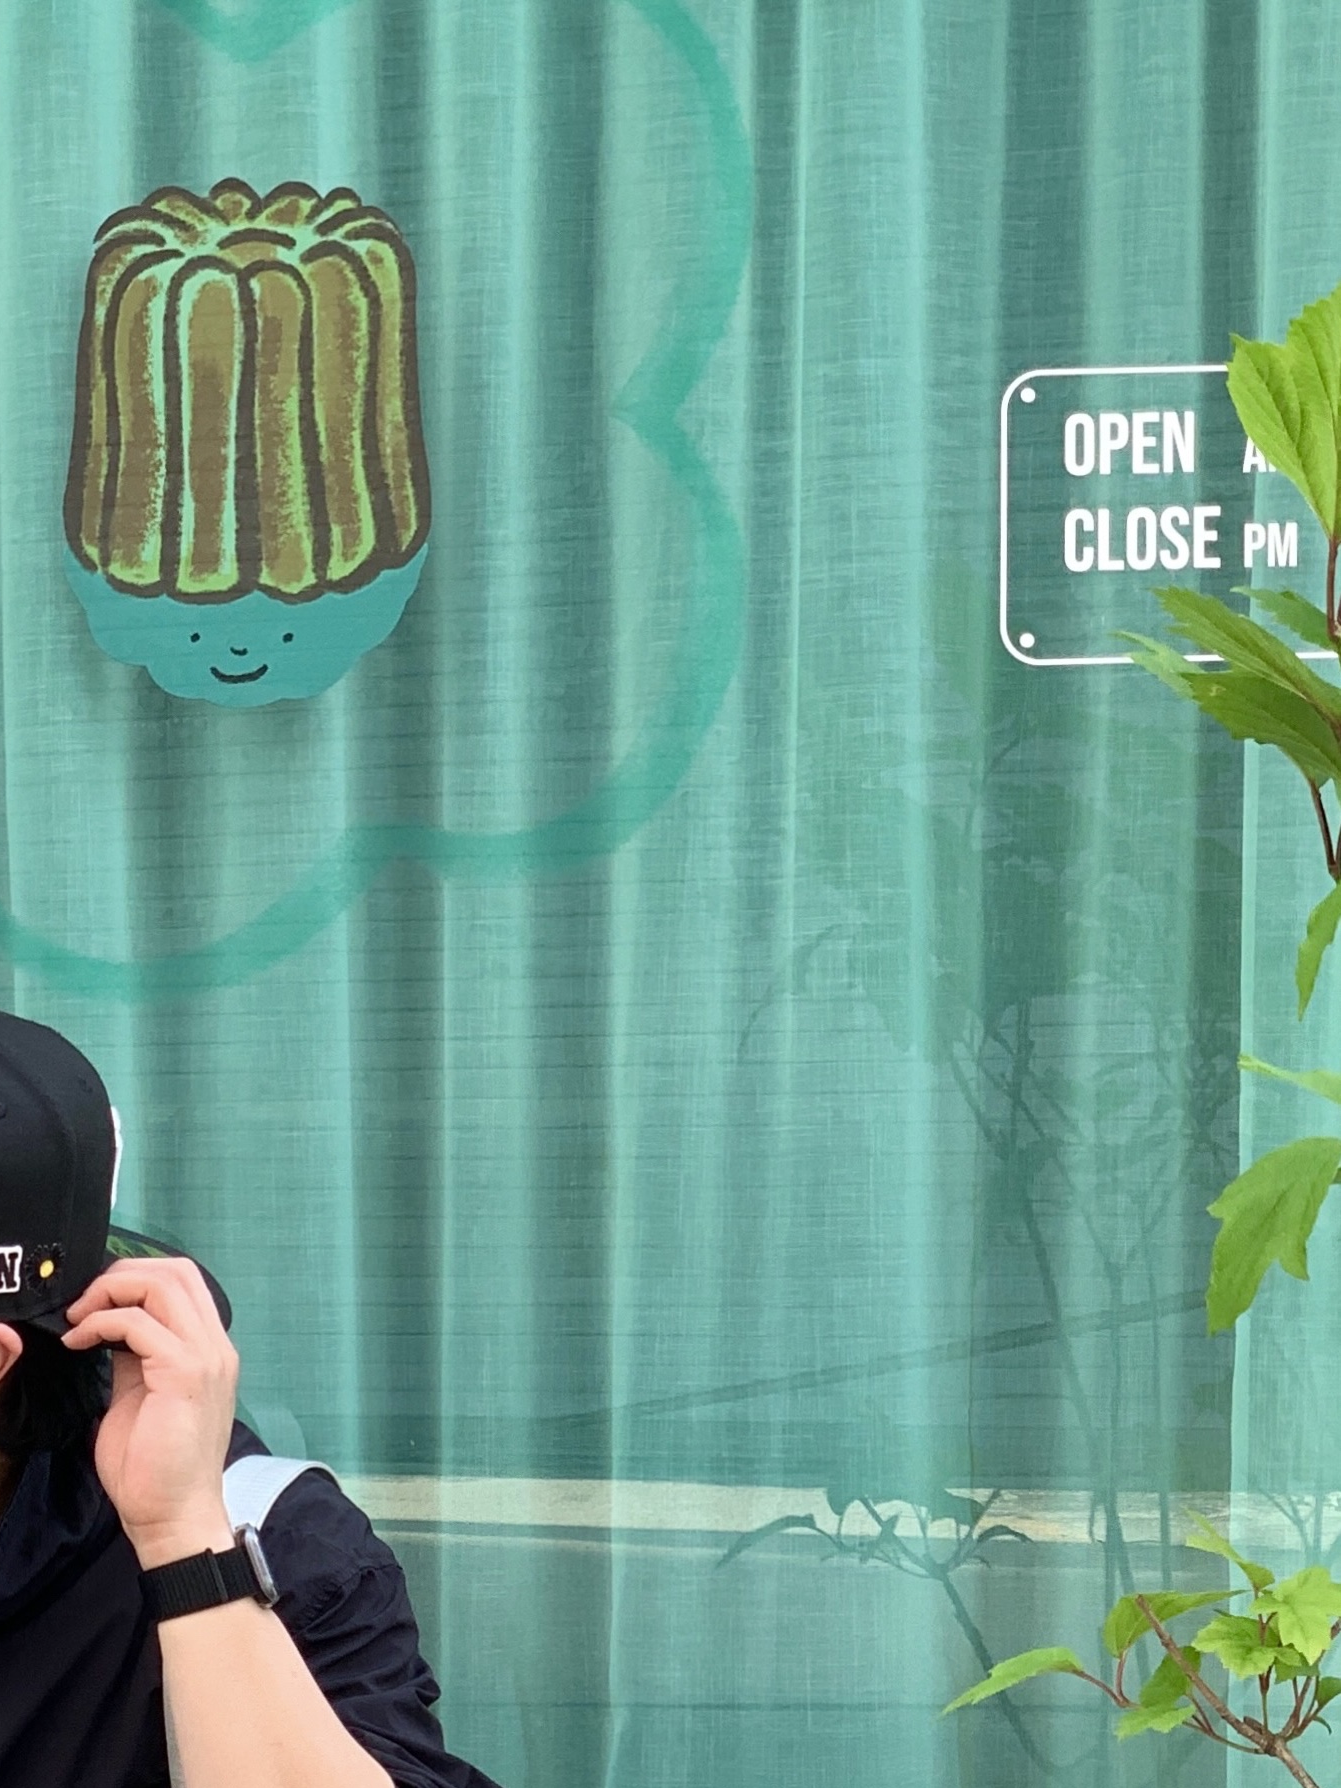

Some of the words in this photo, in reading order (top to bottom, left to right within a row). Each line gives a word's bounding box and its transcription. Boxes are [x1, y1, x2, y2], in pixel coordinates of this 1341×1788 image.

[1064, 410, 1195, 476] OPEN
[1242, 437, 1277, 473] A
[1064, 505, 1221, 572] CLOSE
[1243, 522, 1298, 568] PM
